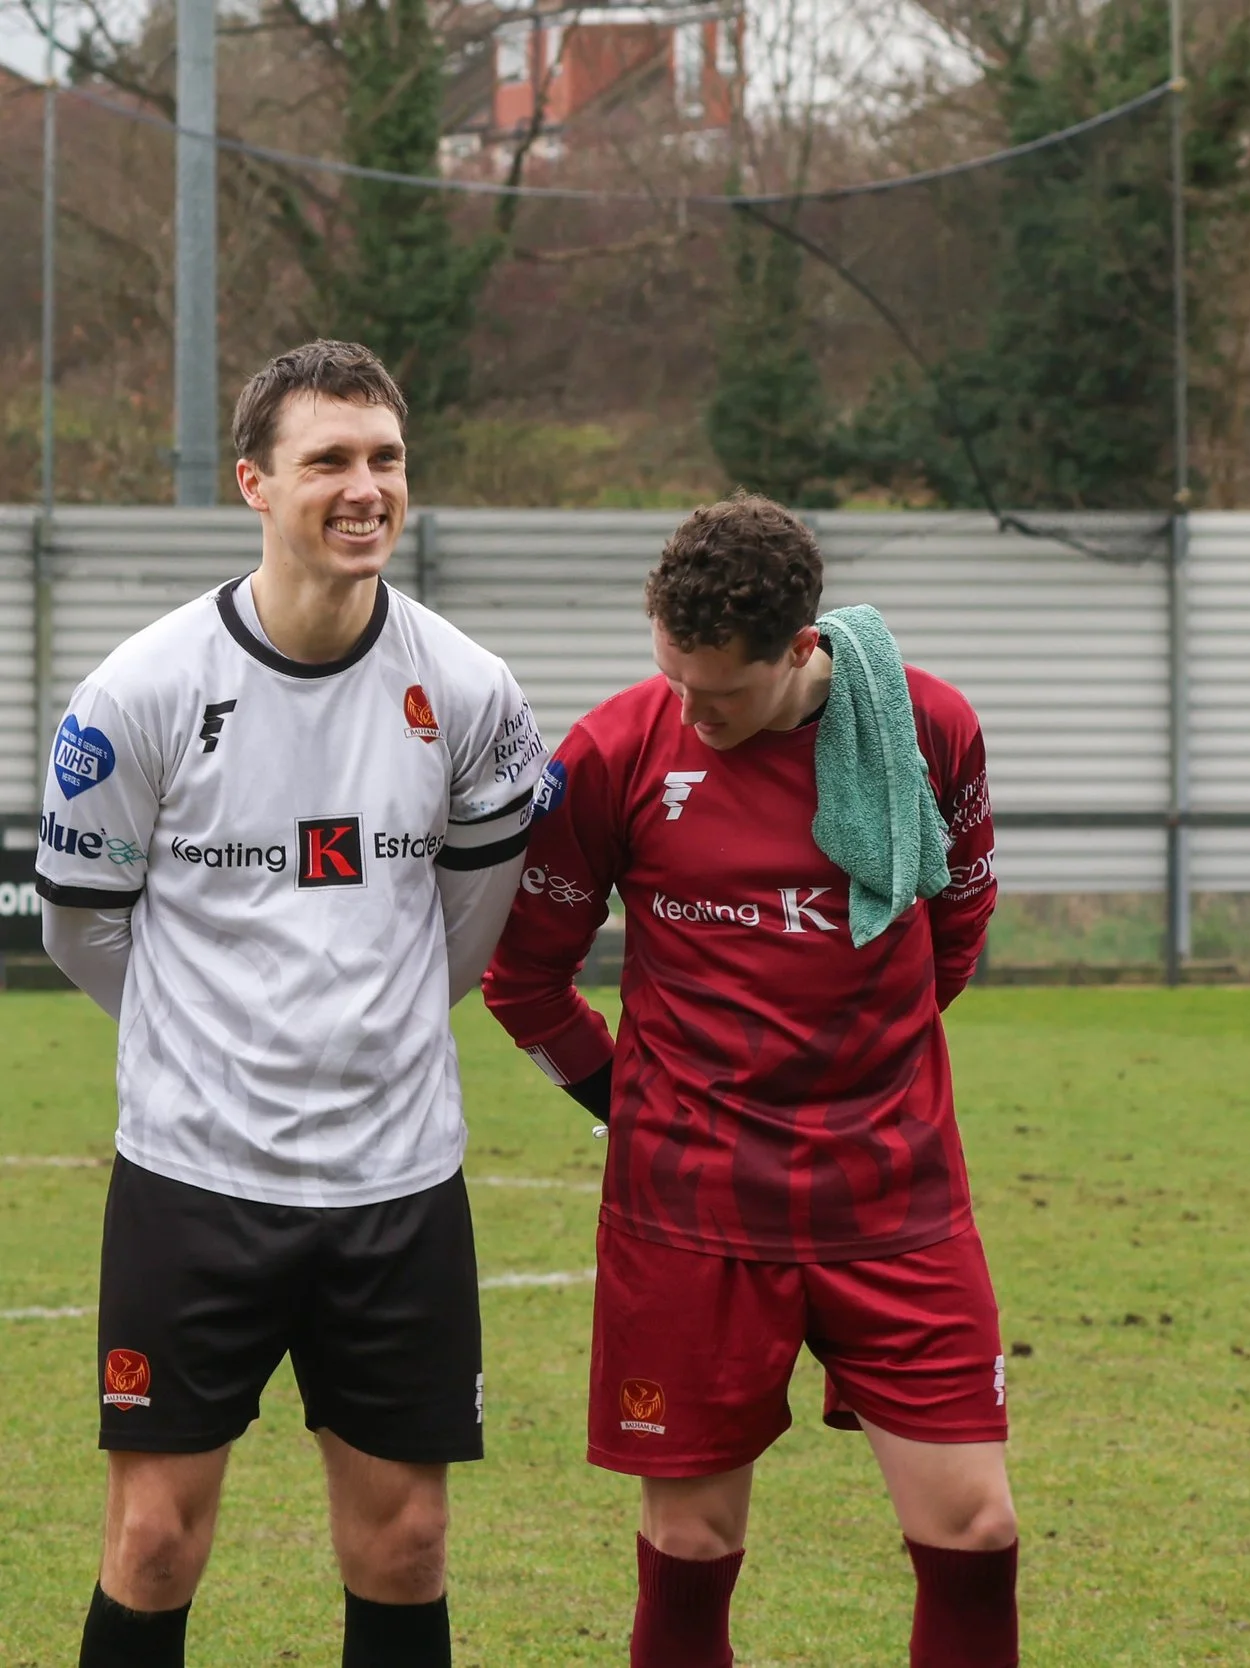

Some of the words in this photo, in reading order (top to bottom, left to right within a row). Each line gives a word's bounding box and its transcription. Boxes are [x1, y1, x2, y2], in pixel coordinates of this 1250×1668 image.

[58, 744, 95, 775] NHS
[171, 836, 287, 873] Keating
[304, 826, 358, 879] K
[653, 891, 760, 926] Keating
[777, 887, 840, 933] K
